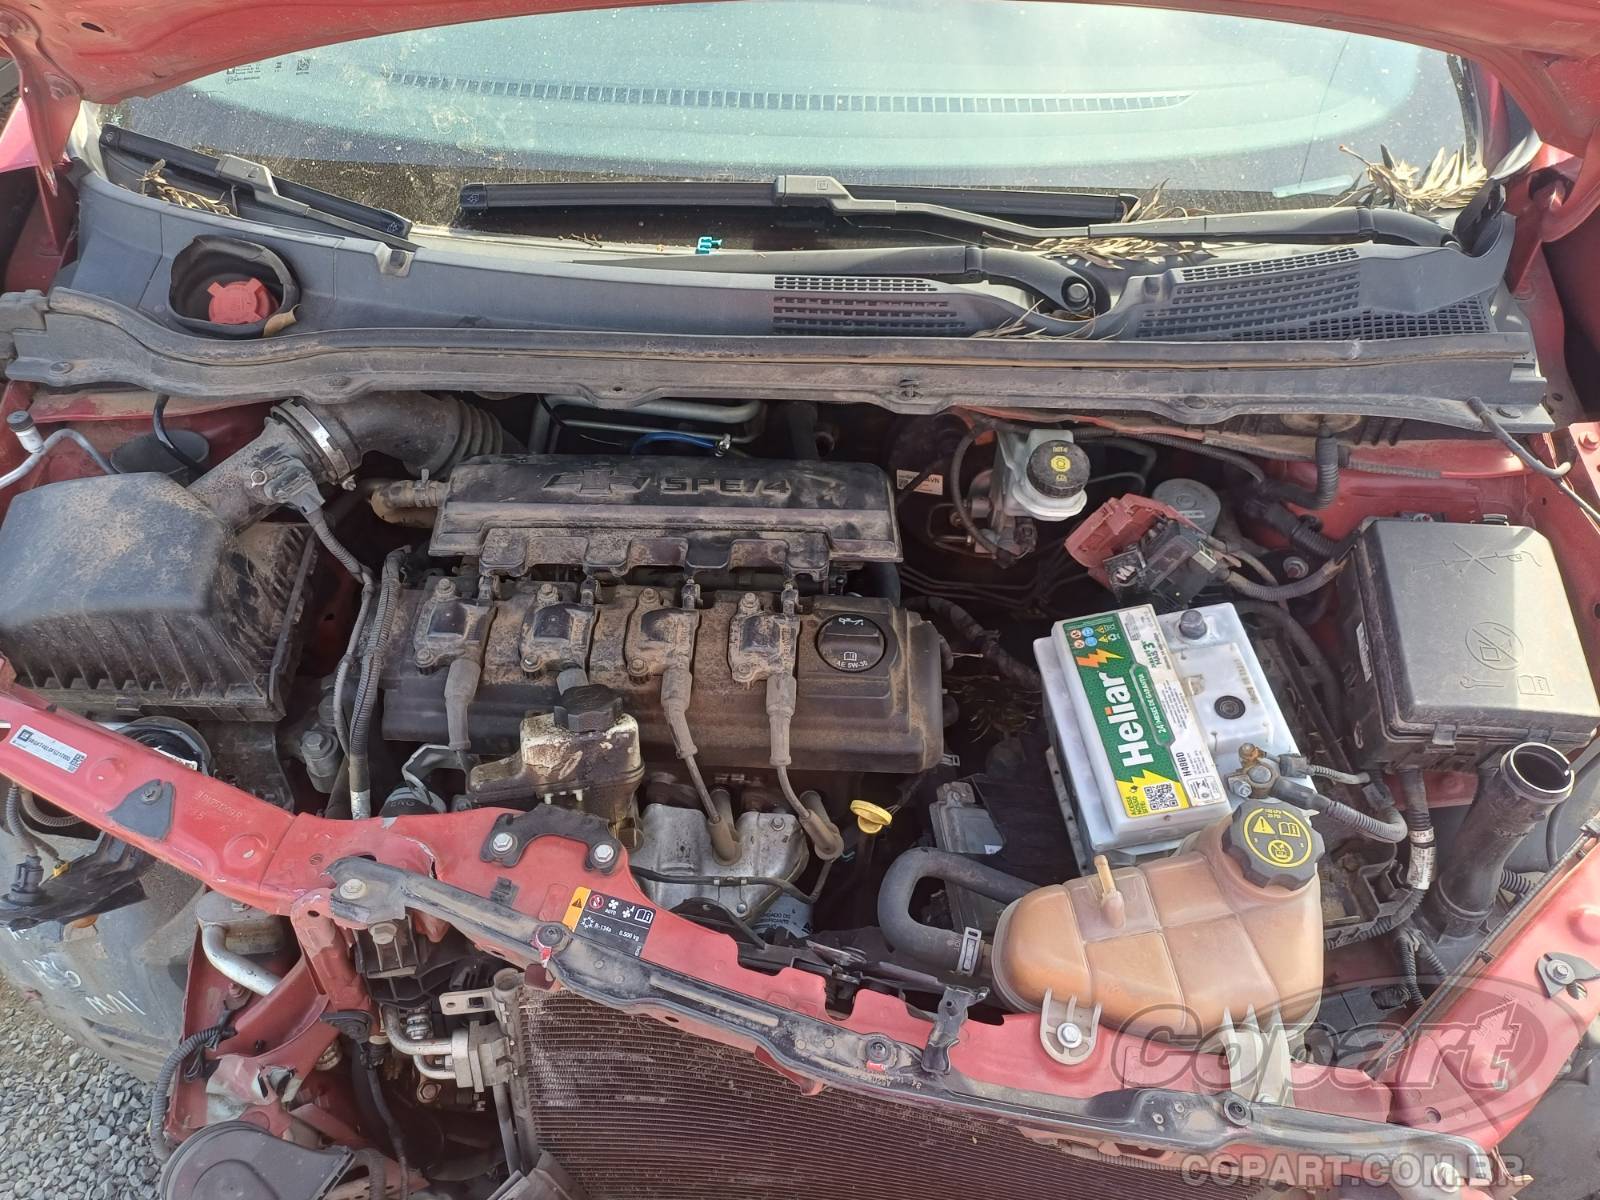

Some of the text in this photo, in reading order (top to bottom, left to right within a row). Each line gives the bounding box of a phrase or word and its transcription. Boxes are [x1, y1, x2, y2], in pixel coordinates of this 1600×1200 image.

[1097, 670, 1154, 767] Heliar
[1136, 673, 1167, 734] 24 MESES DE GARANTIA
[593, 922, 612, 933] R-134a
[632, 934, 640, 942] kg
[604, 908, 617, 916] AUTO
